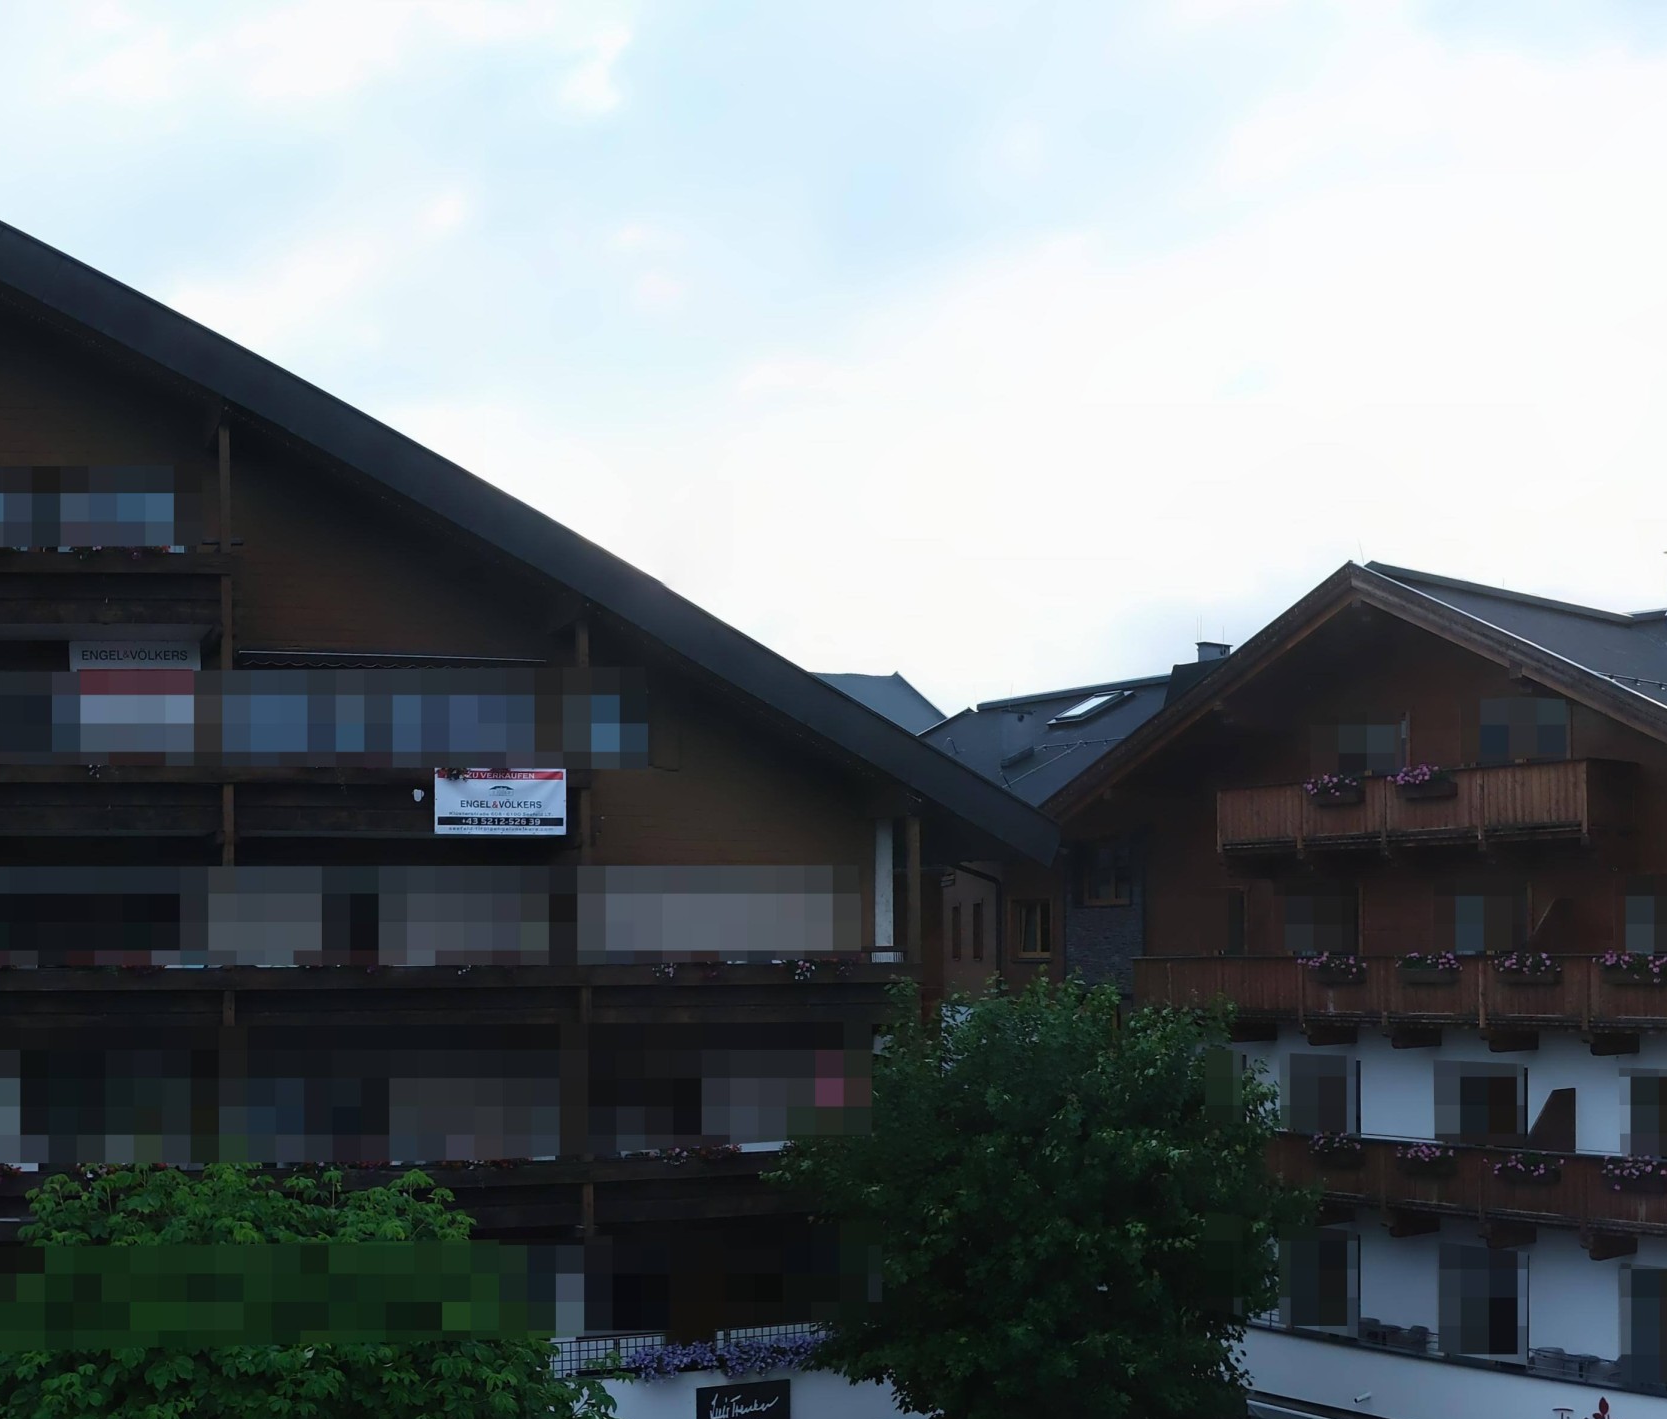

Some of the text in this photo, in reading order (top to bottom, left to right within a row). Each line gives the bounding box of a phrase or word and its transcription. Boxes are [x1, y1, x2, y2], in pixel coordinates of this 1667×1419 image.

[82, 648, 188, 661] ENGEL&VÖLKERS
[481, 771, 535, 779] VERKAUFEN
[461, 799, 542, 808] ENGEL&VÖLKERS
